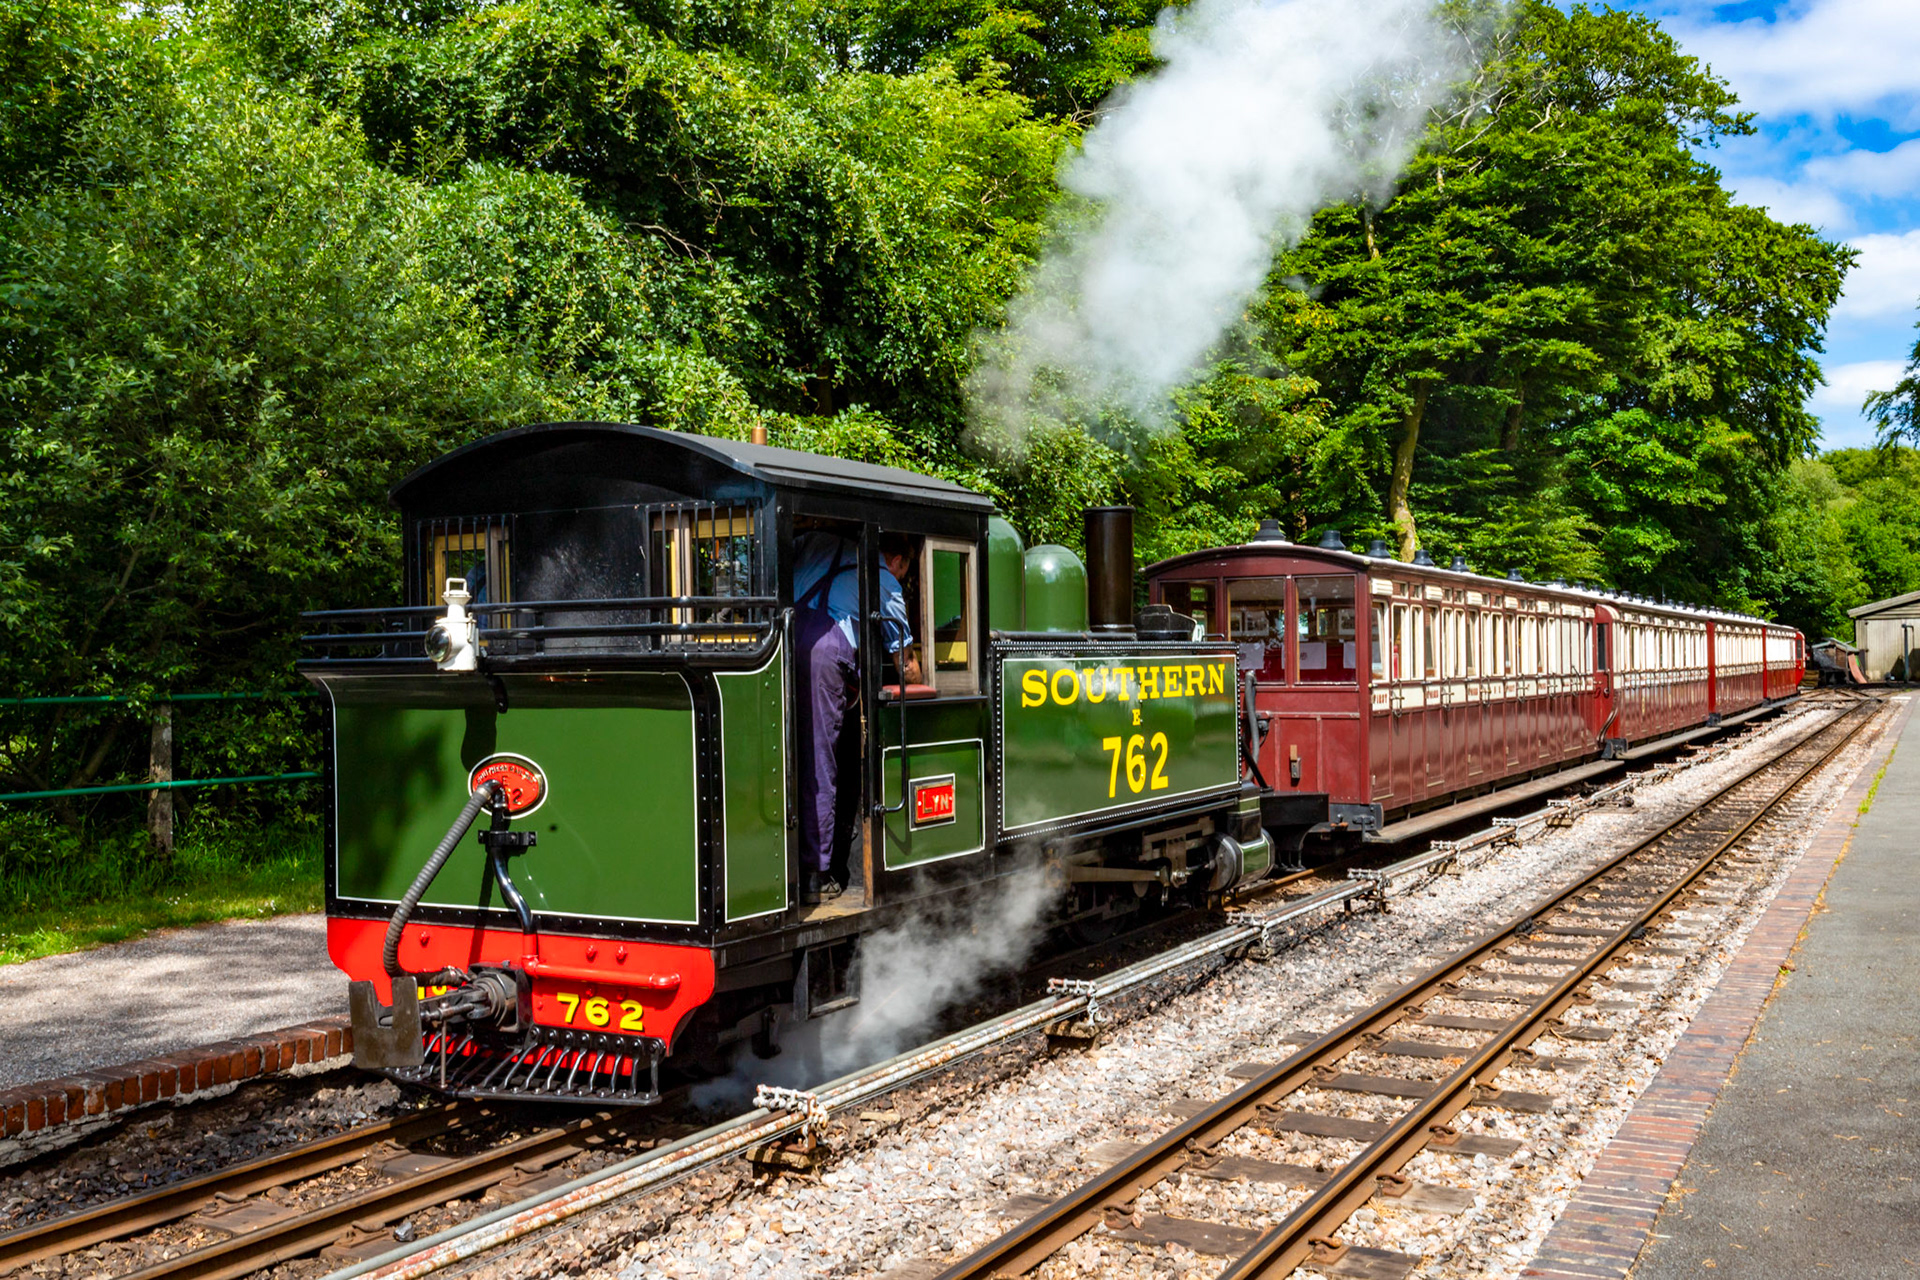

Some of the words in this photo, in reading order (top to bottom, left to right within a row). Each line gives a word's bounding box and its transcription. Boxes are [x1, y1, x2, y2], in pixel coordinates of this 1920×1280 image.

[1022, 664, 1226, 708] SOUTHERN
[1132, 709, 1141, 726] E
[1102, 731, 1169, 799] 762
[557, 992, 644, 1032] 762
